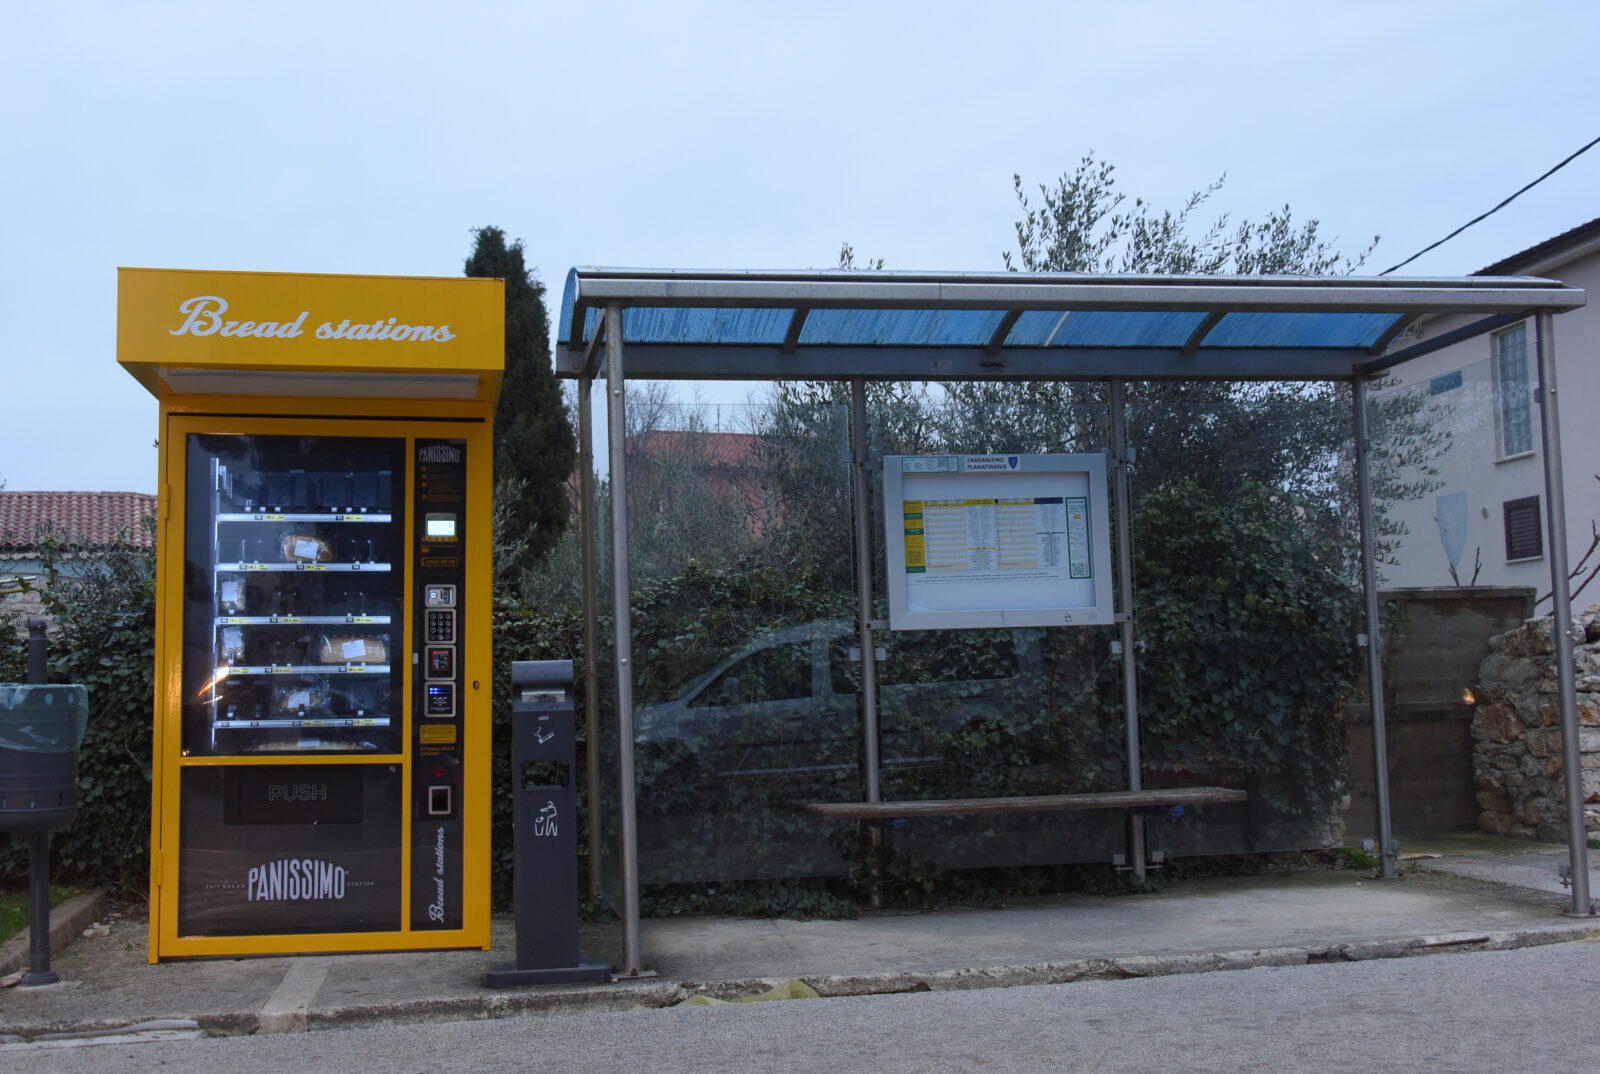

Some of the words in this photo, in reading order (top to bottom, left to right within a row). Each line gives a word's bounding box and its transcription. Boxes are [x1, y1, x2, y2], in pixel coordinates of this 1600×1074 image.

[169, 295, 310, 338] Bread
[315, 317, 456, 342] stations
[418, 445, 460, 463] PANISSIMO
[269, 784, 327, 801] PUSH
[434, 826, 445, 876] stations
[248, 859, 345, 901] PANISSIMO
[428, 877, 445, 924] Bread
